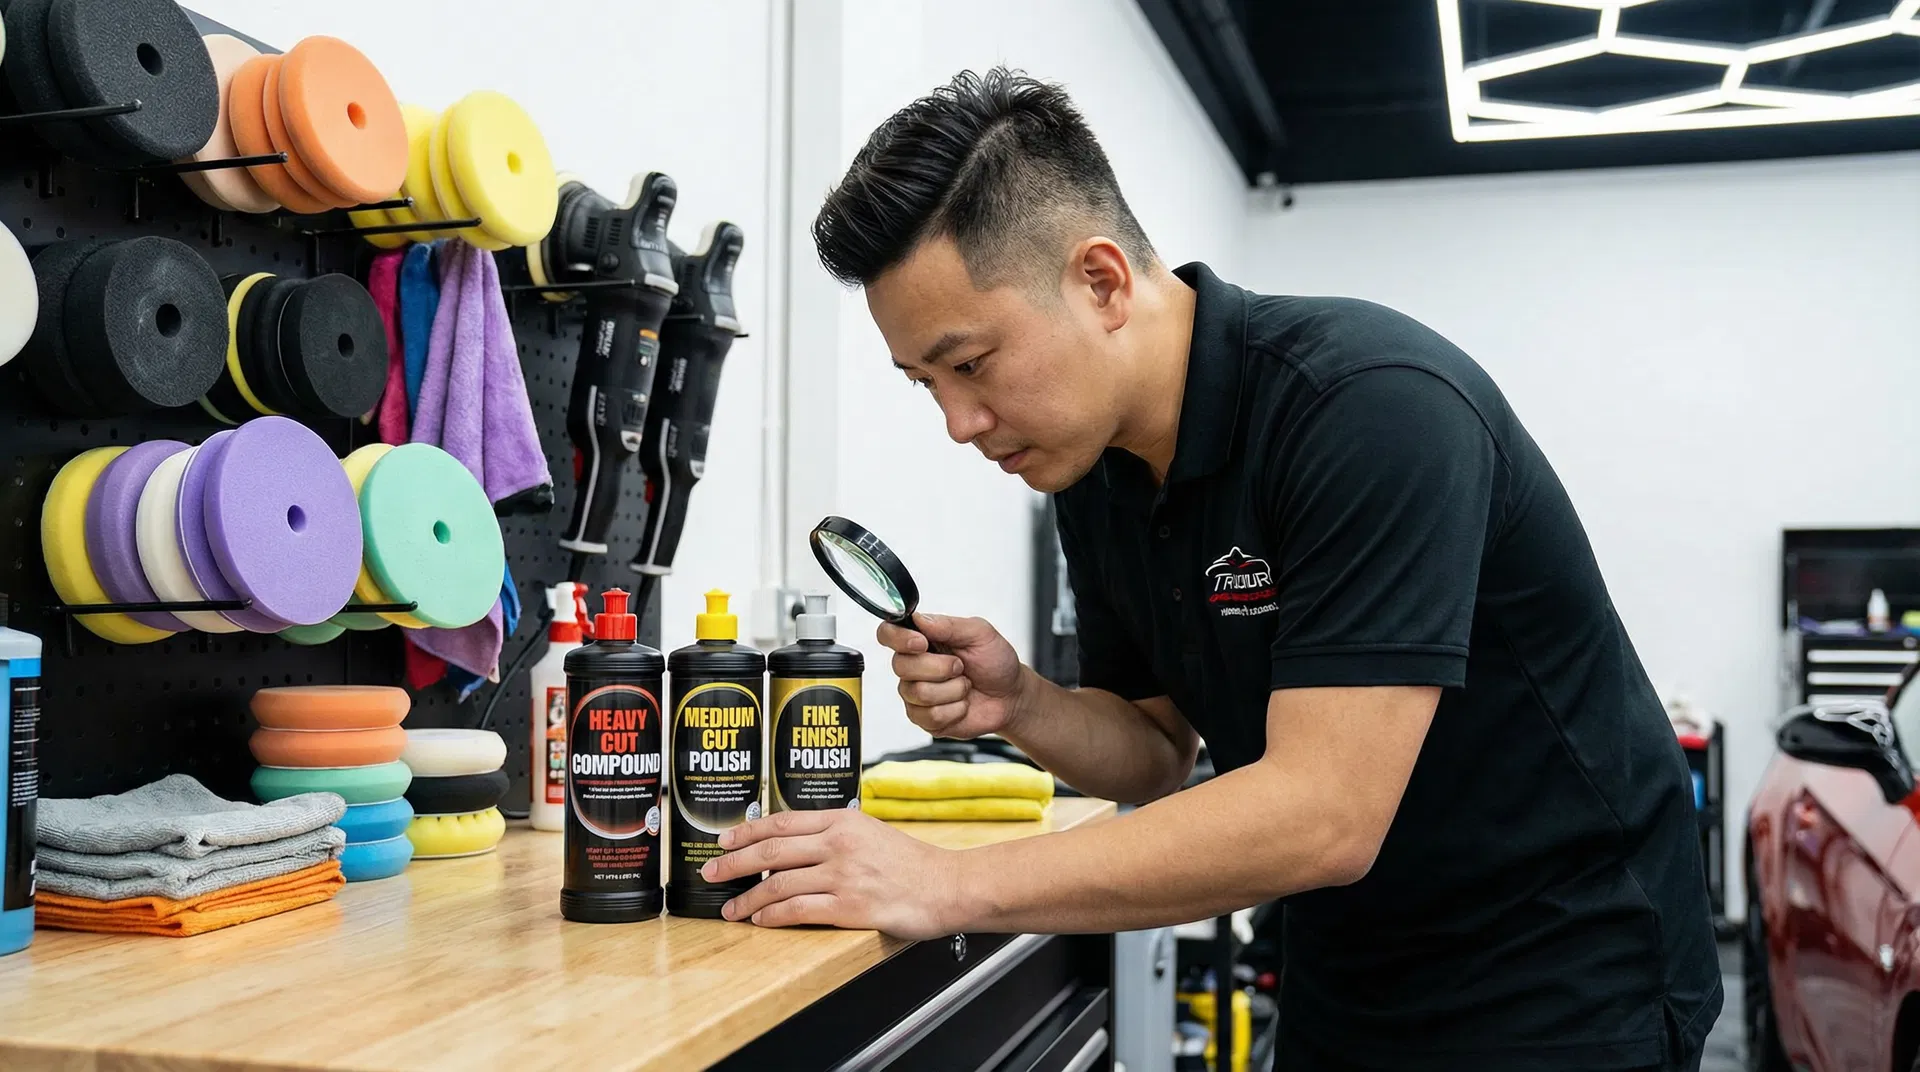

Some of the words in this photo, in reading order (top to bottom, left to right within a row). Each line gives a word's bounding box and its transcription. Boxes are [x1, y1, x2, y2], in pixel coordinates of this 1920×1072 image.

[589, 709, 648, 731] HEAVY
[684, 706, 755, 728] MEDIUM
[802, 705, 840, 726] FINE
[600, 732, 639, 754] CUT
[702, 729, 740, 750] CUT
[792, 726, 849, 748] FINISH
[572, 752, 661, 776] COMPOUND
[689, 750, 751, 772] POLISH
[789, 747, 851, 770] POLISH
